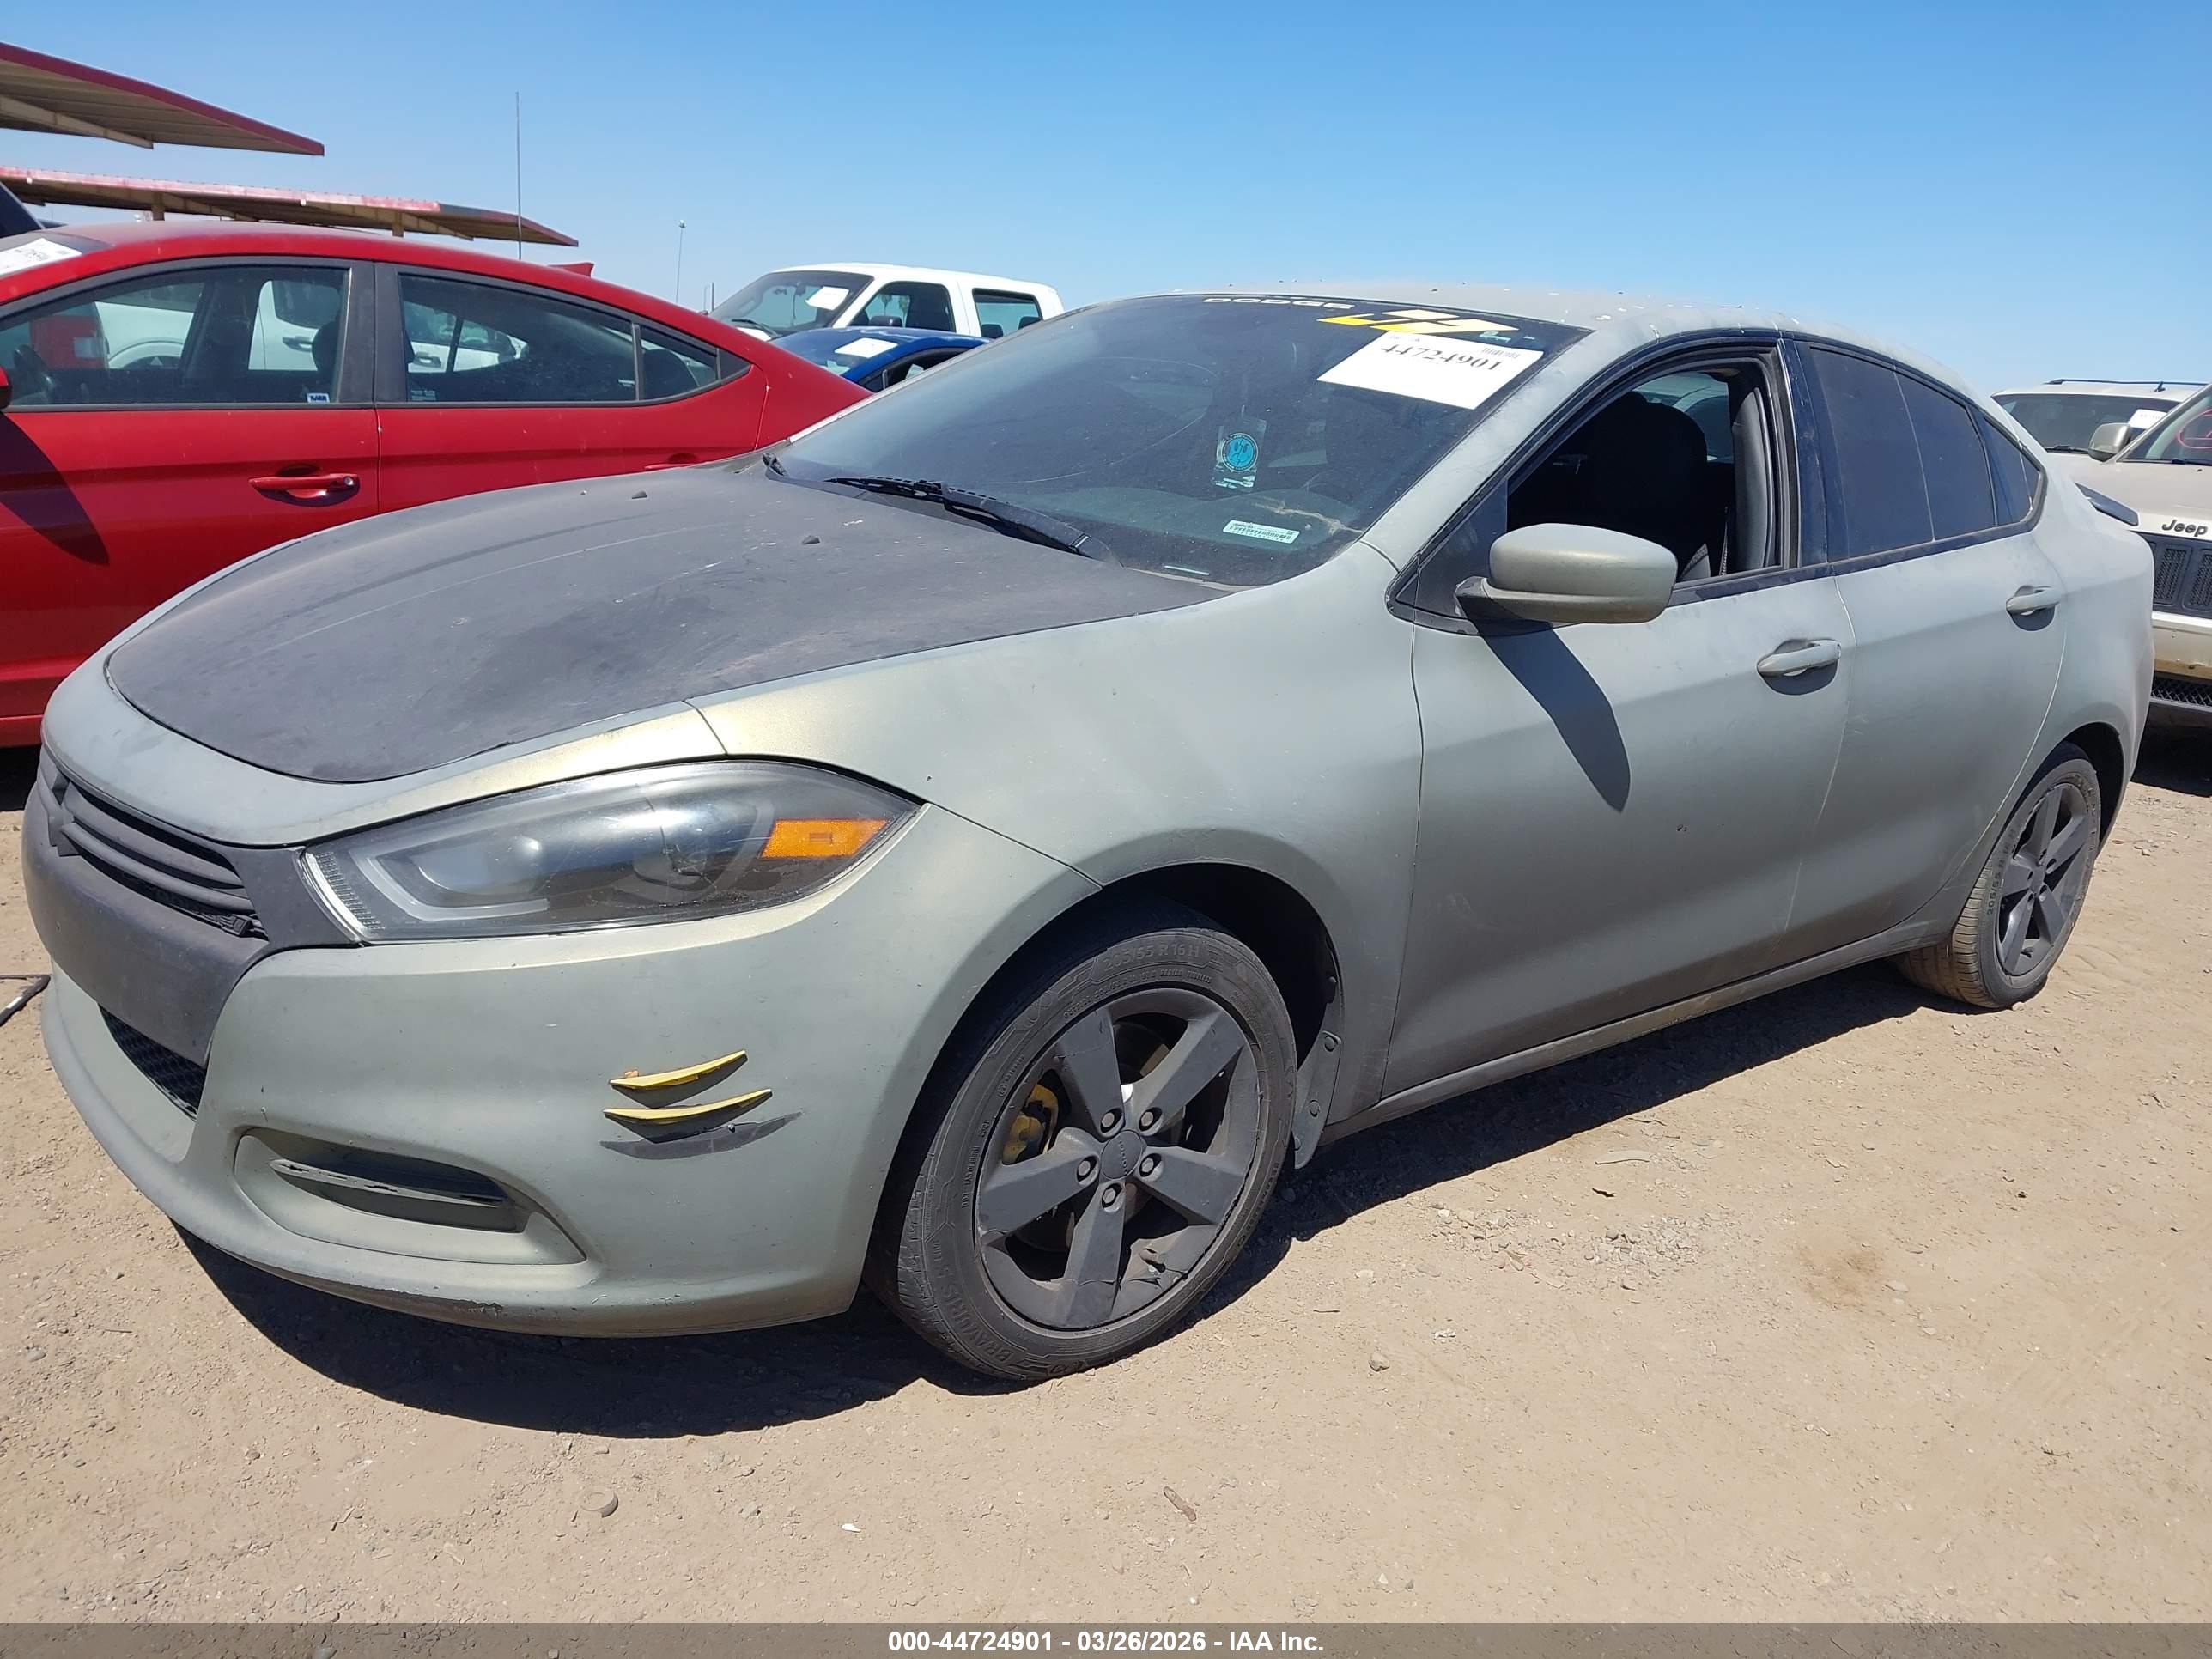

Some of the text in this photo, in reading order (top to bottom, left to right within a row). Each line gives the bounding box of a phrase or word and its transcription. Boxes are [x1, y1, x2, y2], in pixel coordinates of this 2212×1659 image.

[1203, 297, 1355, 310] DODGE
[1381, 343, 1502, 370] 44724901
[2161, 519, 2208, 538] Jeep
